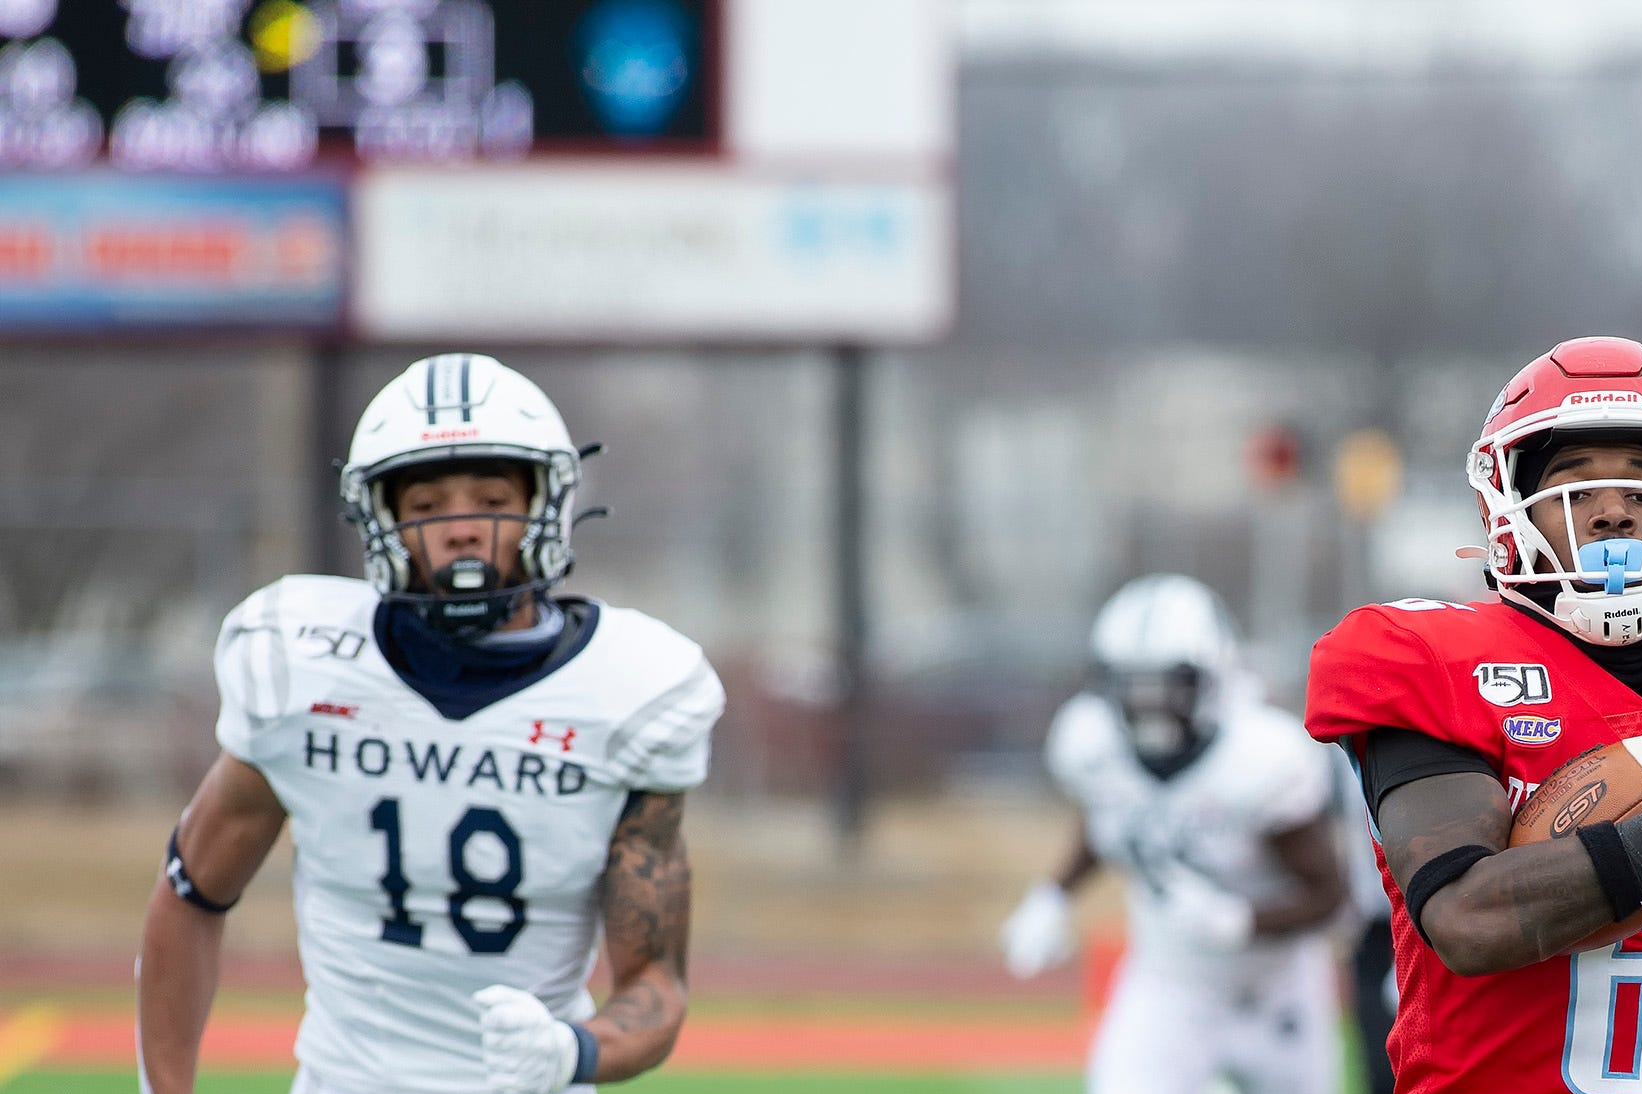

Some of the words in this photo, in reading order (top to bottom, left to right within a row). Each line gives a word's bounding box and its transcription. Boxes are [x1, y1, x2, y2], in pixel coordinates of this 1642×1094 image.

[1604, 608, 1639, 619] Riddell
[1480, 666, 1549, 704] 150
[1508, 719, 1559, 738] MEAC
[304, 730, 586, 796] HOWARD
[1553, 782, 1602, 834] GST
[369, 796, 526, 955] 18
